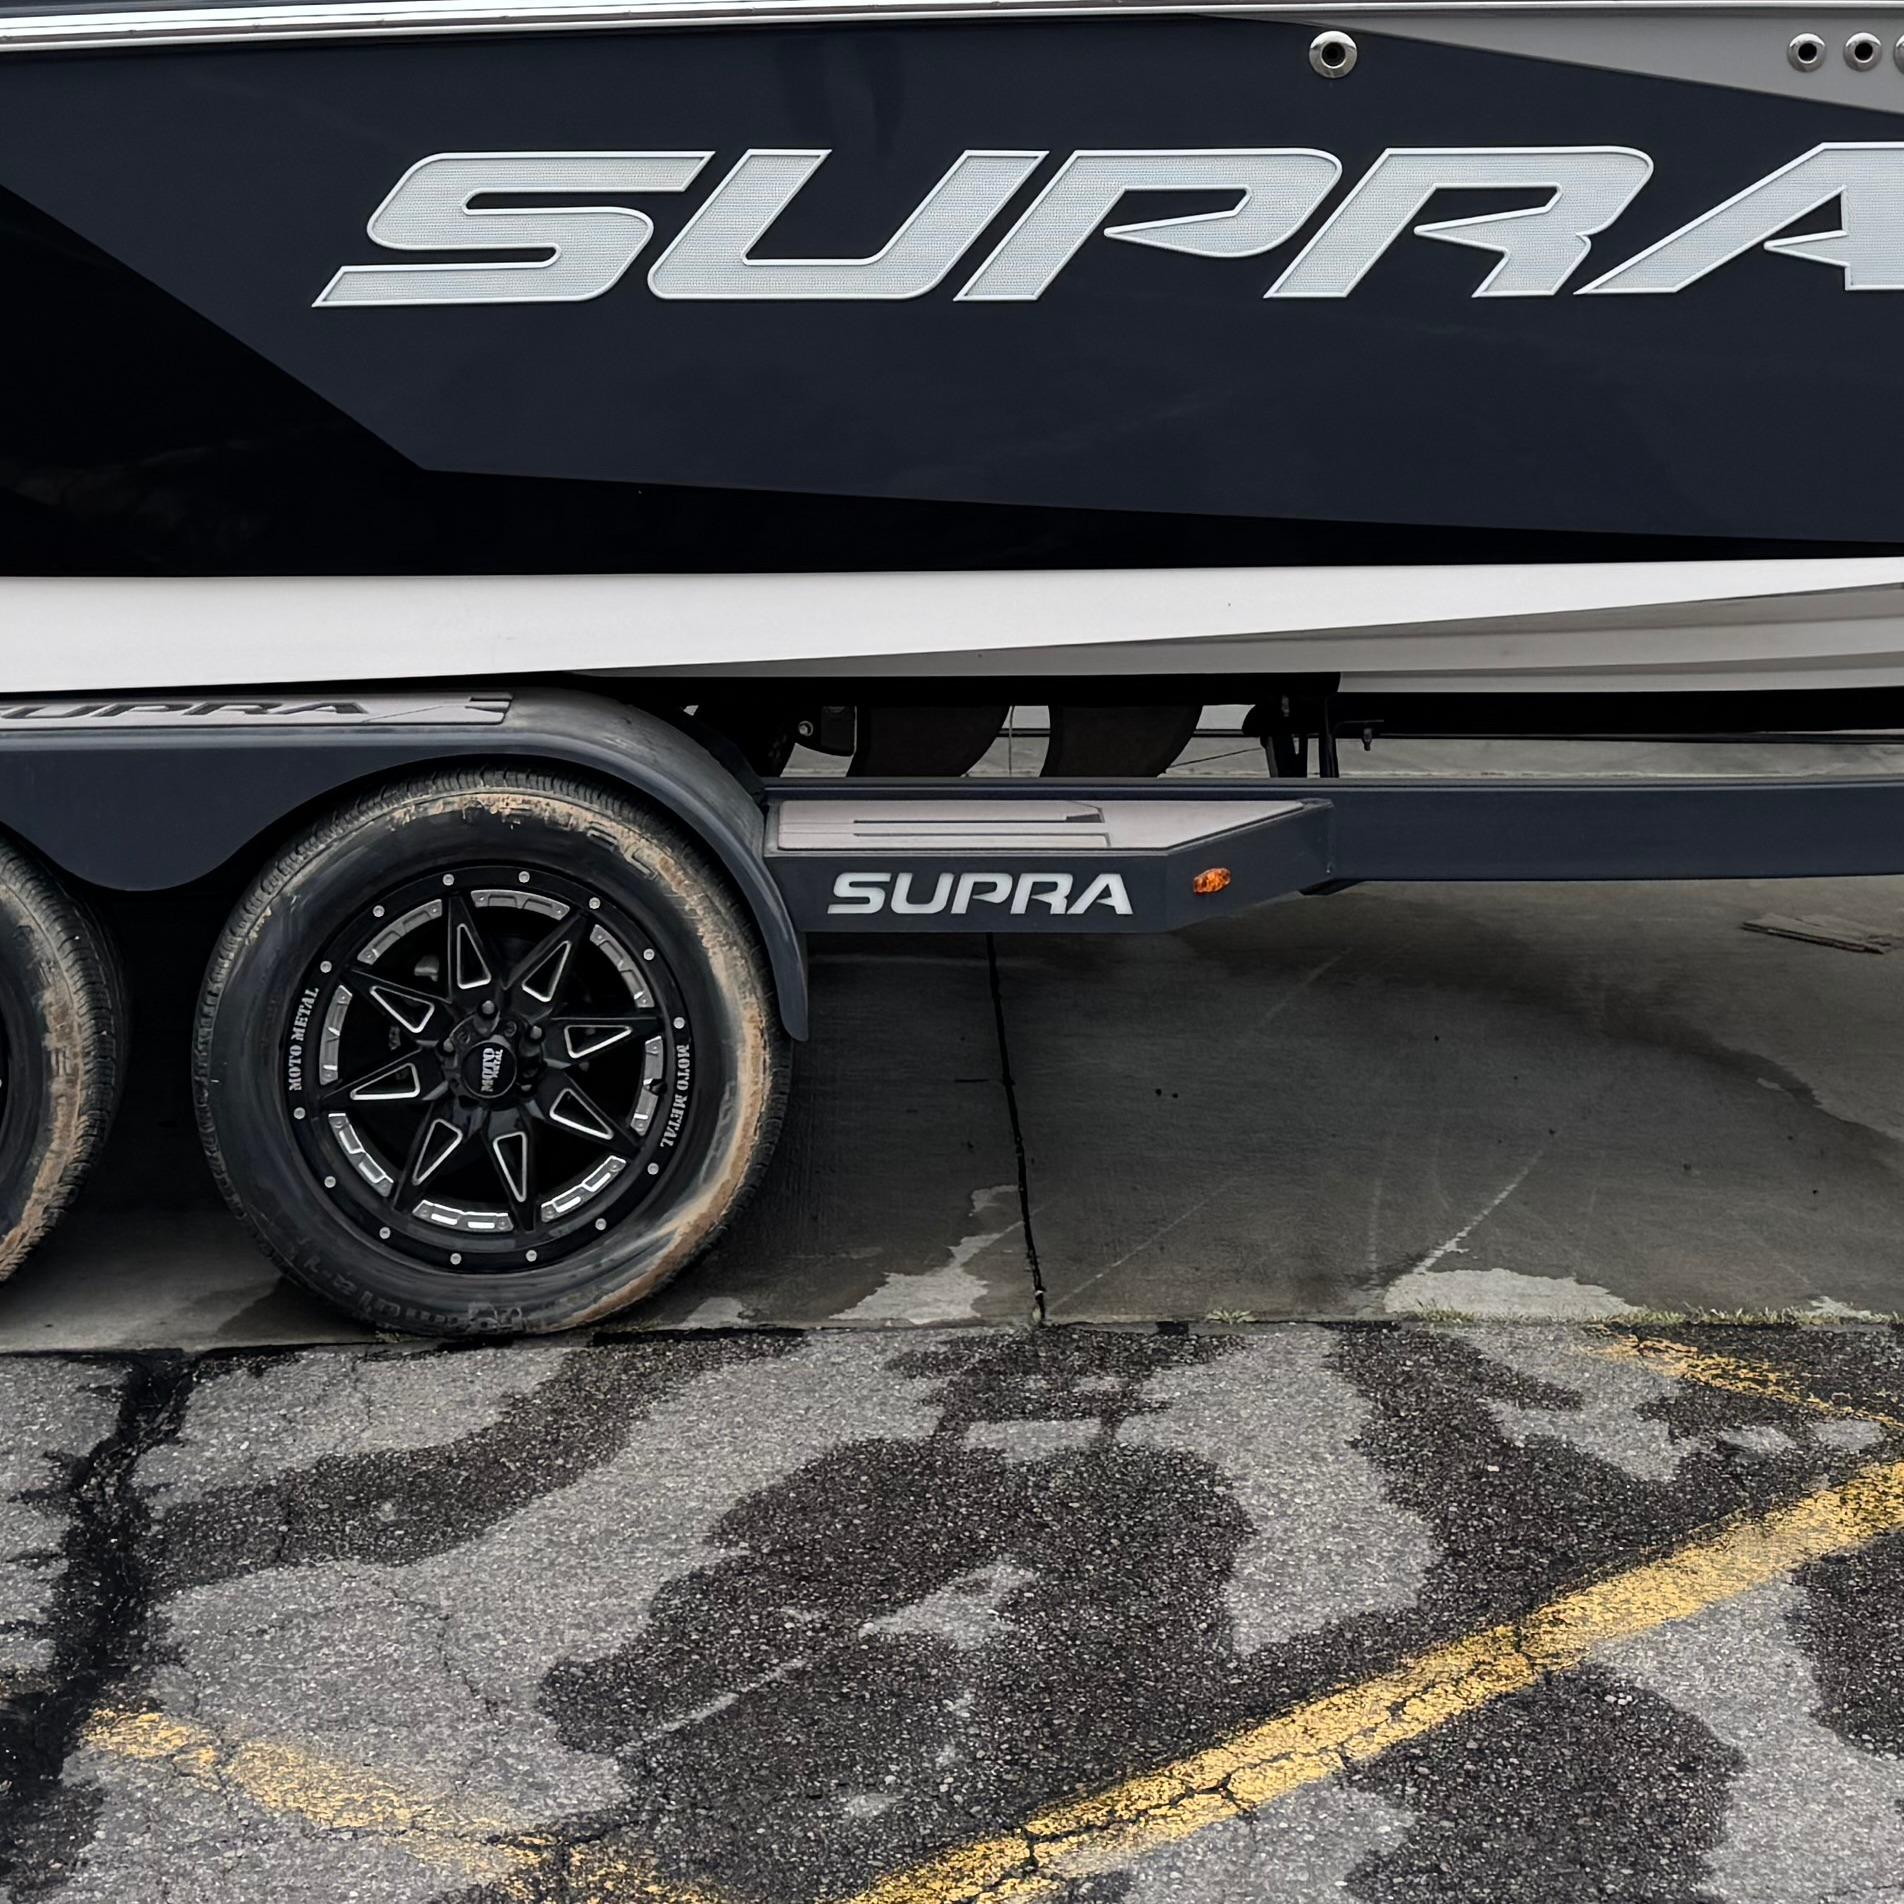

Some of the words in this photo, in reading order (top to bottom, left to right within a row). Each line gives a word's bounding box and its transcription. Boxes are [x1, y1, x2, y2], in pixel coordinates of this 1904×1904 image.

[827, 872, 1134, 915] SUPRA
[291, 988, 319, 1041] METAL
[288, 1045, 302, 1091] MOTO
[480, 1048, 495, 1092] MOTO
[676, 1044, 690, 1091] MOTO
[660, 1094, 687, 1148] METAL
